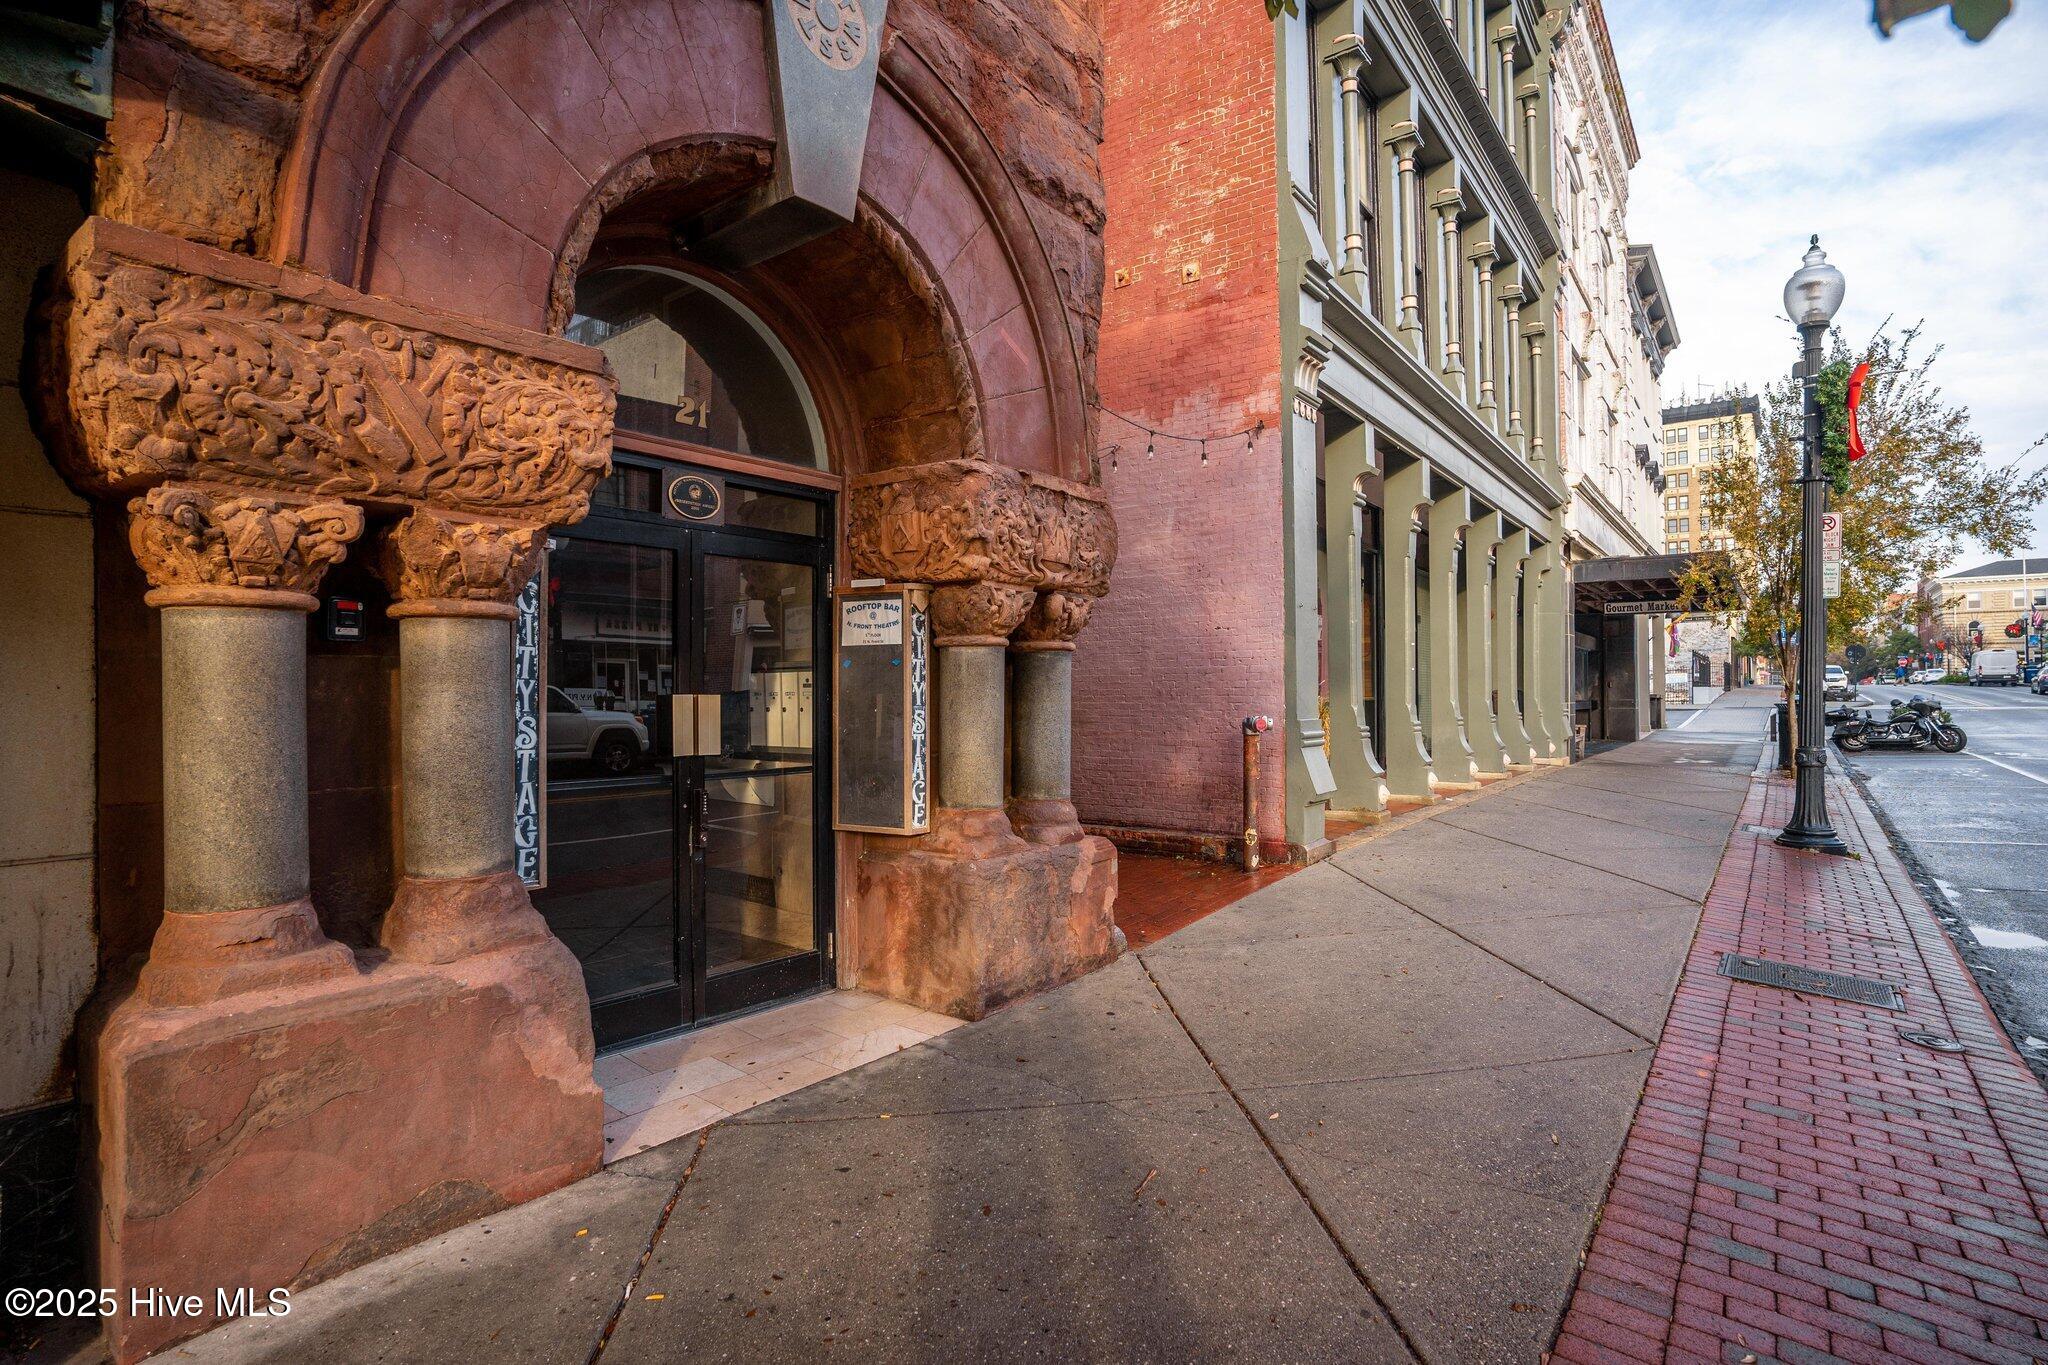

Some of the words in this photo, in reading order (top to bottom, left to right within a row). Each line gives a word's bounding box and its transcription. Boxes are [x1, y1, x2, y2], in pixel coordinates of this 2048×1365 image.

[675, 396, 707, 429] 21
[846, 603, 882, 615] ROOFTOP
[883, 603, 900, 613] BAR
[1605, 602, 1644, 613] Gourmet
[874, 619, 900, 628] THEATRE
